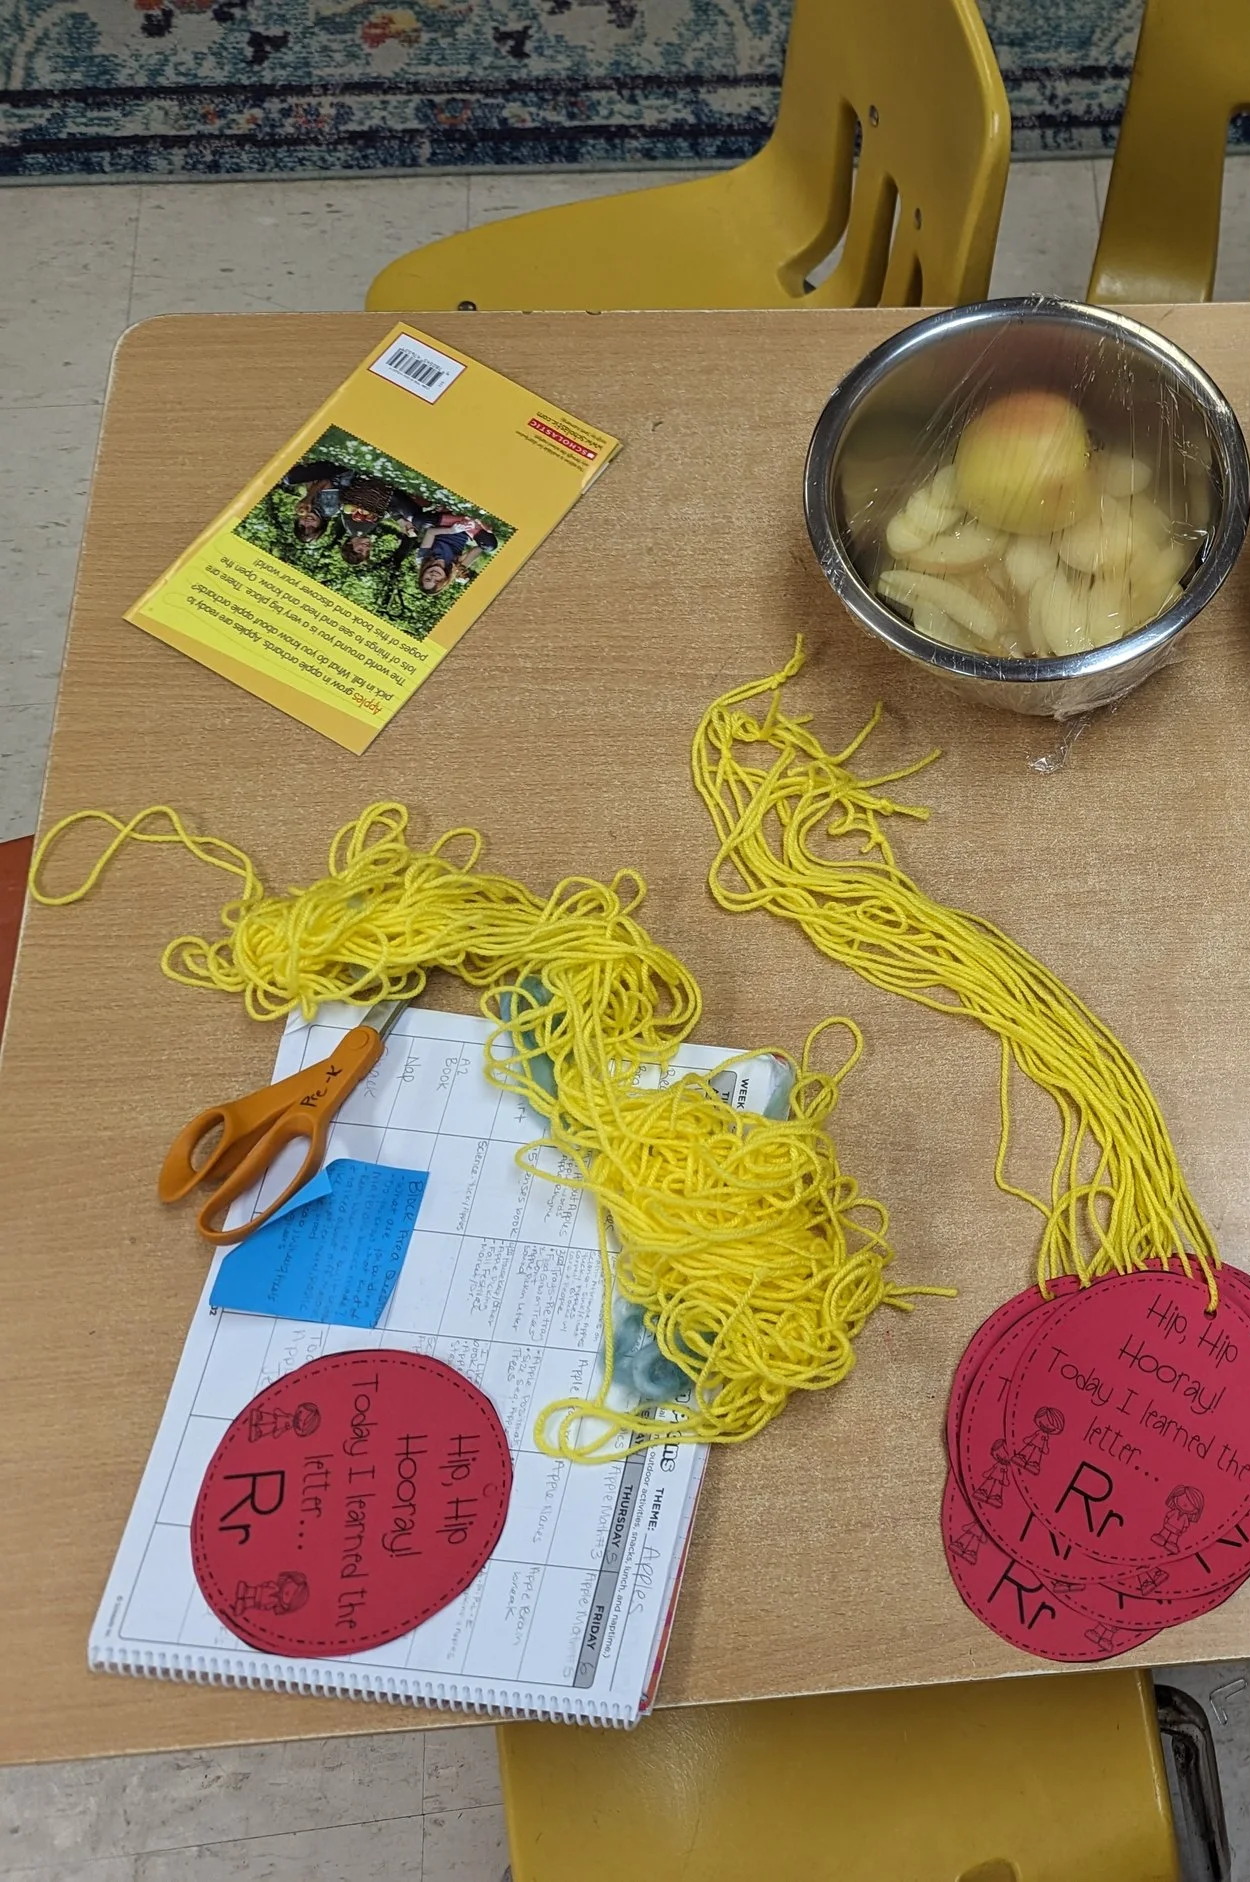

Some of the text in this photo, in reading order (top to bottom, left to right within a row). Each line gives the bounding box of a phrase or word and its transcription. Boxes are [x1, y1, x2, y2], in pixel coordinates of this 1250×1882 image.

[530, 420, 588, 455] SCHOLASTIC
[536, 411, 603, 451] www.scholastic.com
[205, 564, 406, 687] The world around you is a very big place. There are
[219, 556, 417, 676] lots of things to see and hear and know. Open the
[252, 558, 429, 662] pages of this book and discover your world!
[186, 595, 383, 716] Apples grow in apple orchards. Apples are ready to
[190, 584, 394, 702] pick in fall. What do you know about apple orchards?
[299, 1064, 343, 1108] Pre-K
[396, 1055, 421, 1083] Nap
[436, 1057, 458, 1094] Book
[736, 1078, 750, 1109] WEEK
[402, 1180, 425, 1222] Block
[390, 1229, 410, 1262] Area
[1146, 1294, 1238, 1369] Hip, Hip
[569, 1359, 589, 1393] Apple
[1118, 1333, 1226, 1415] Hooray!
[1047, 1346, 1114, 1407] Today
[1115, 1388, 1140, 1416] I
[1140, 1399, 1216, 1459] learned
[435, 1433, 481, 1545] Hip, Hip
[545, 1460, 564, 1499] Apple
[602, 1465, 621, 1502] Apple
[643, 1451, 657, 1486] outdoor
[218, 1469, 286, 1545] Rr
[335, 1373, 379, 1630] Today I learned the
[381, 1433, 428, 1558] Hooray!
[611, 1484, 634, 1548] THURSDAY
[632, 1487, 648, 1530] activities,
[1054, 1460, 1124, 1537] Rr
[624, 1531, 638, 1564] snacks,
[632, 1487, 665, 1617] THEME: Apples
[521, 1567, 541, 1601] Apple
[578, 1572, 596, 1606] Apple
[617, 1565, 632, 1593] lunch,
[987, 1557, 1056, 1630] Rr
[613, 1594, 624, 1613] and
[586, 1605, 605, 1651] FRIDAY
[602, 1614, 619, 1659] naptime.)
